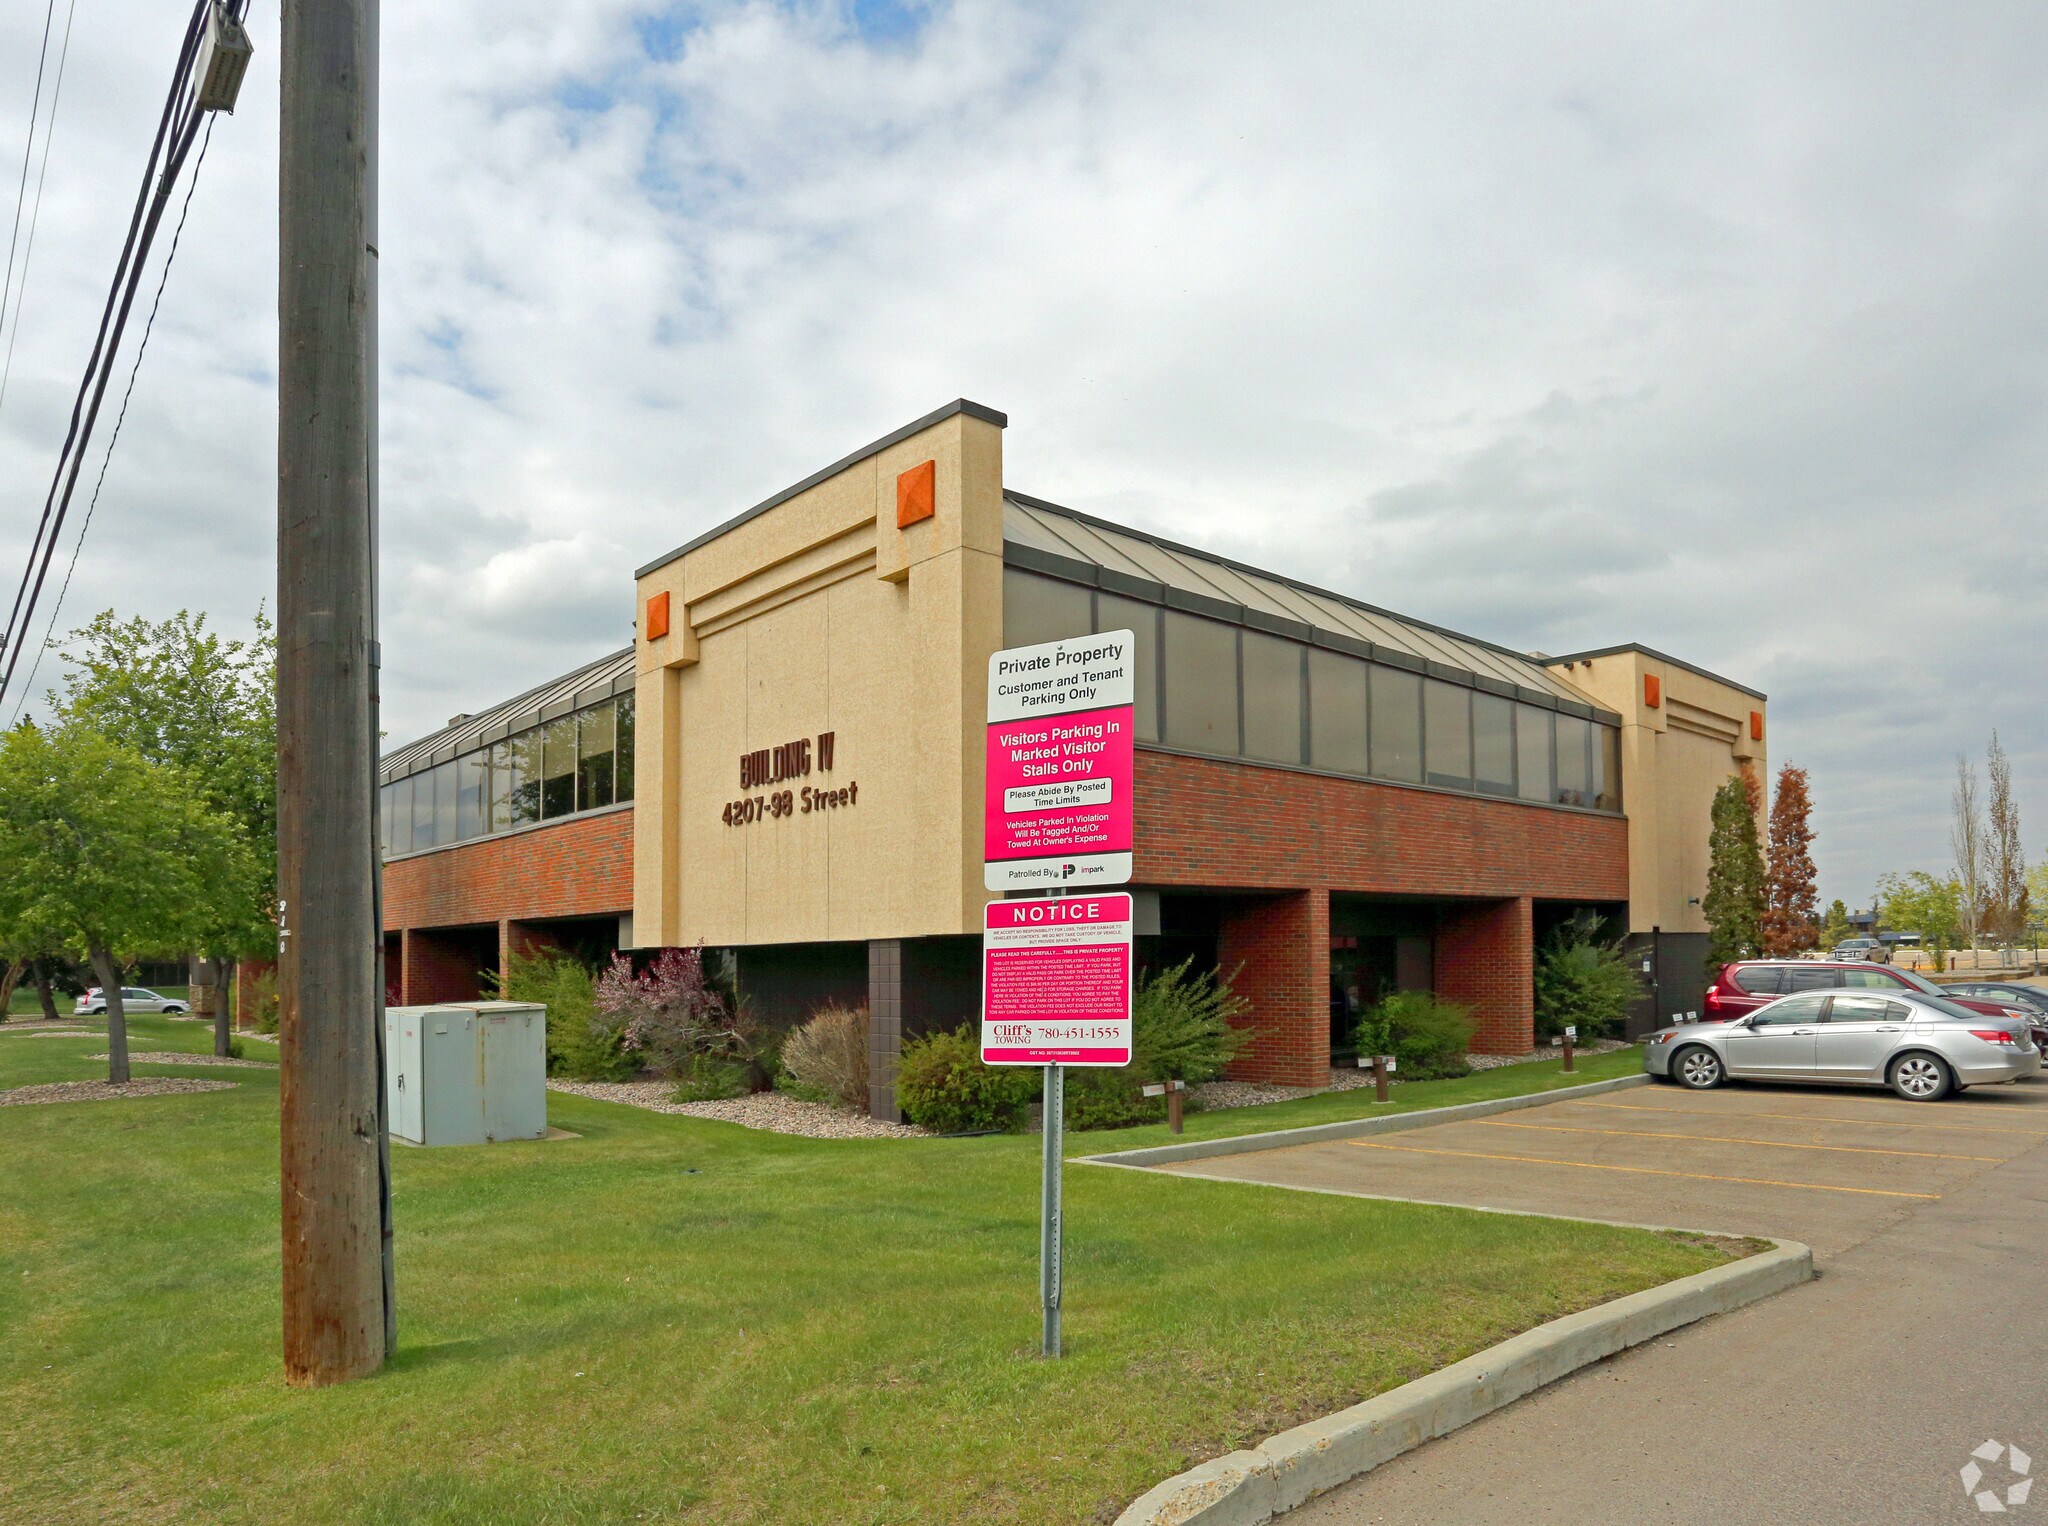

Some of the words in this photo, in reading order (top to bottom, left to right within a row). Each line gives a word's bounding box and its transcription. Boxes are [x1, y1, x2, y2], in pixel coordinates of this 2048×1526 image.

[999, 655, 1050, 675] Private
[1056, 644, 1123, 667] Property
[998, 679, 1052, 696] Customer
[1057, 674, 1078, 687] and
[1083, 667, 1123, 683] Tenant
[1022, 691, 1065, 707] Parking
[1070, 687, 1096, 700] Only
[1000, 729, 1047, 747] Visitors
[1052, 724, 1102, 742] Parking
[1108, 721, 1119, 733] In
[1011, 743, 1059, 763] Marked
[1063, 739, 1105, 756] Visitor
[740, 738, 811, 790] BUILDING
[818, 732, 835, 771] IV
[1022, 760, 1058, 778] Stalls
[1063, 758, 1093, 774] Only
[1010, 788, 1035, 799] Please
[1038, 786, 1061, 796] Abide
[1064, 785, 1073, 795] By
[1077, 782, 1105, 793] Posted
[722, 790, 793, 826] 4207-98
[801, 781, 858, 813] Street
[1034, 797, 1053, 807] Time
[1056, 795, 1080, 805] Limits
[1007, 819, 1036, 829] Vehicles
[1038, 816, 1065, 827] Parked
[1067, 816, 1073, 824] In
[1075, 813, 1108, 823] Violation
[1015, 829, 1028, 838] Will
[1030, 829, 1040, 837] Be
[1042, 826, 1070, 837] Tagged
[1072, 824, 1099, 833] And/Or
[1007, 839, 1031, 848] Towed
[1033, 838, 1041, 846] At
[1043, 836, 1072, 846] Owner's
[1075, 834, 1107, 845] Expense
[1008, 869, 1042, 879] Patrolled
[1081, 865, 1104, 875] impark
[1014, 903, 1100, 922] NOTICE
[993, 1024, 1032, 1036] Cliff's
[1038, 1027, 1119, 1039] 780-451-1555
[995, 1036, 1031, 1044] TOWING
